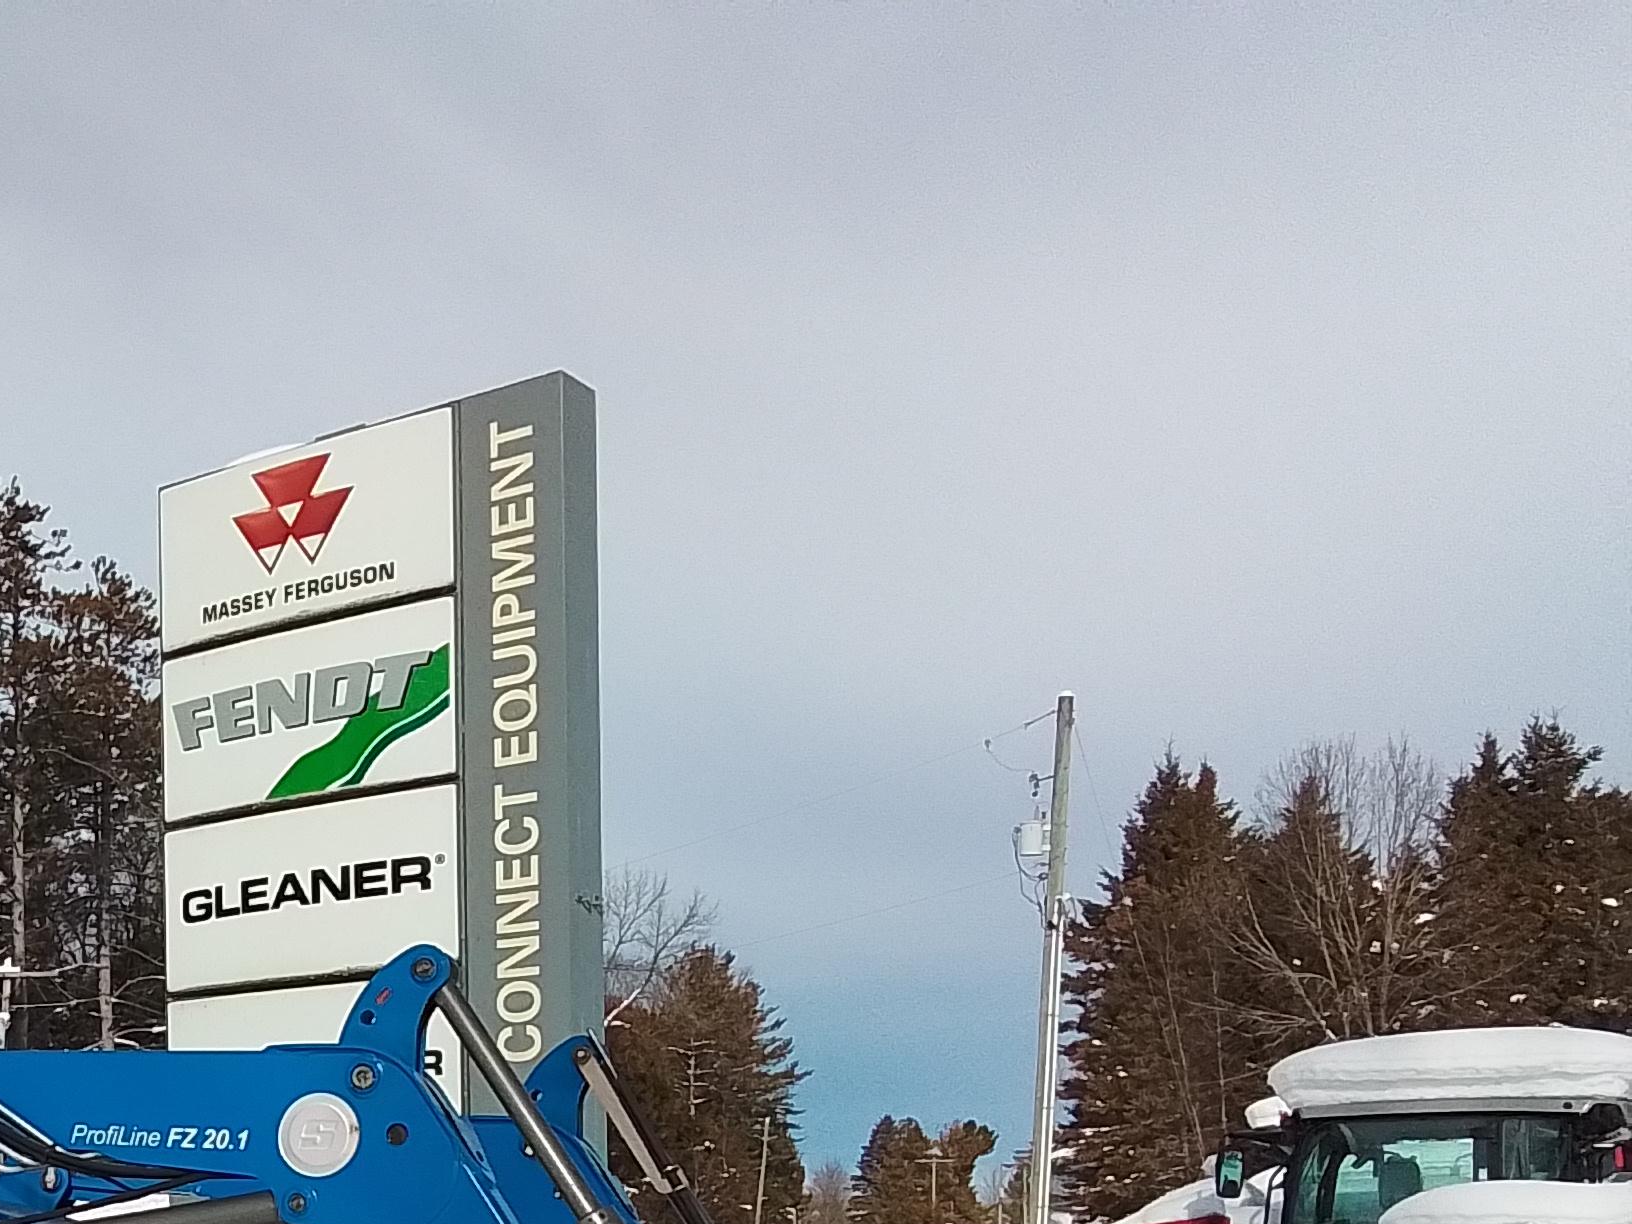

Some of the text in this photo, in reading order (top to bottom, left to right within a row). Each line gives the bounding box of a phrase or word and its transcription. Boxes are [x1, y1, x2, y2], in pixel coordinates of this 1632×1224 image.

[202, 561, 395, 625] MASSEY FERGUSON
[171, 650, 435, 752] FENDT
[489, 421, 542, 1063] CONNECT EQUIPMENT
[70, 1123, 250, 1151] ProfiLine FZ 20.1
